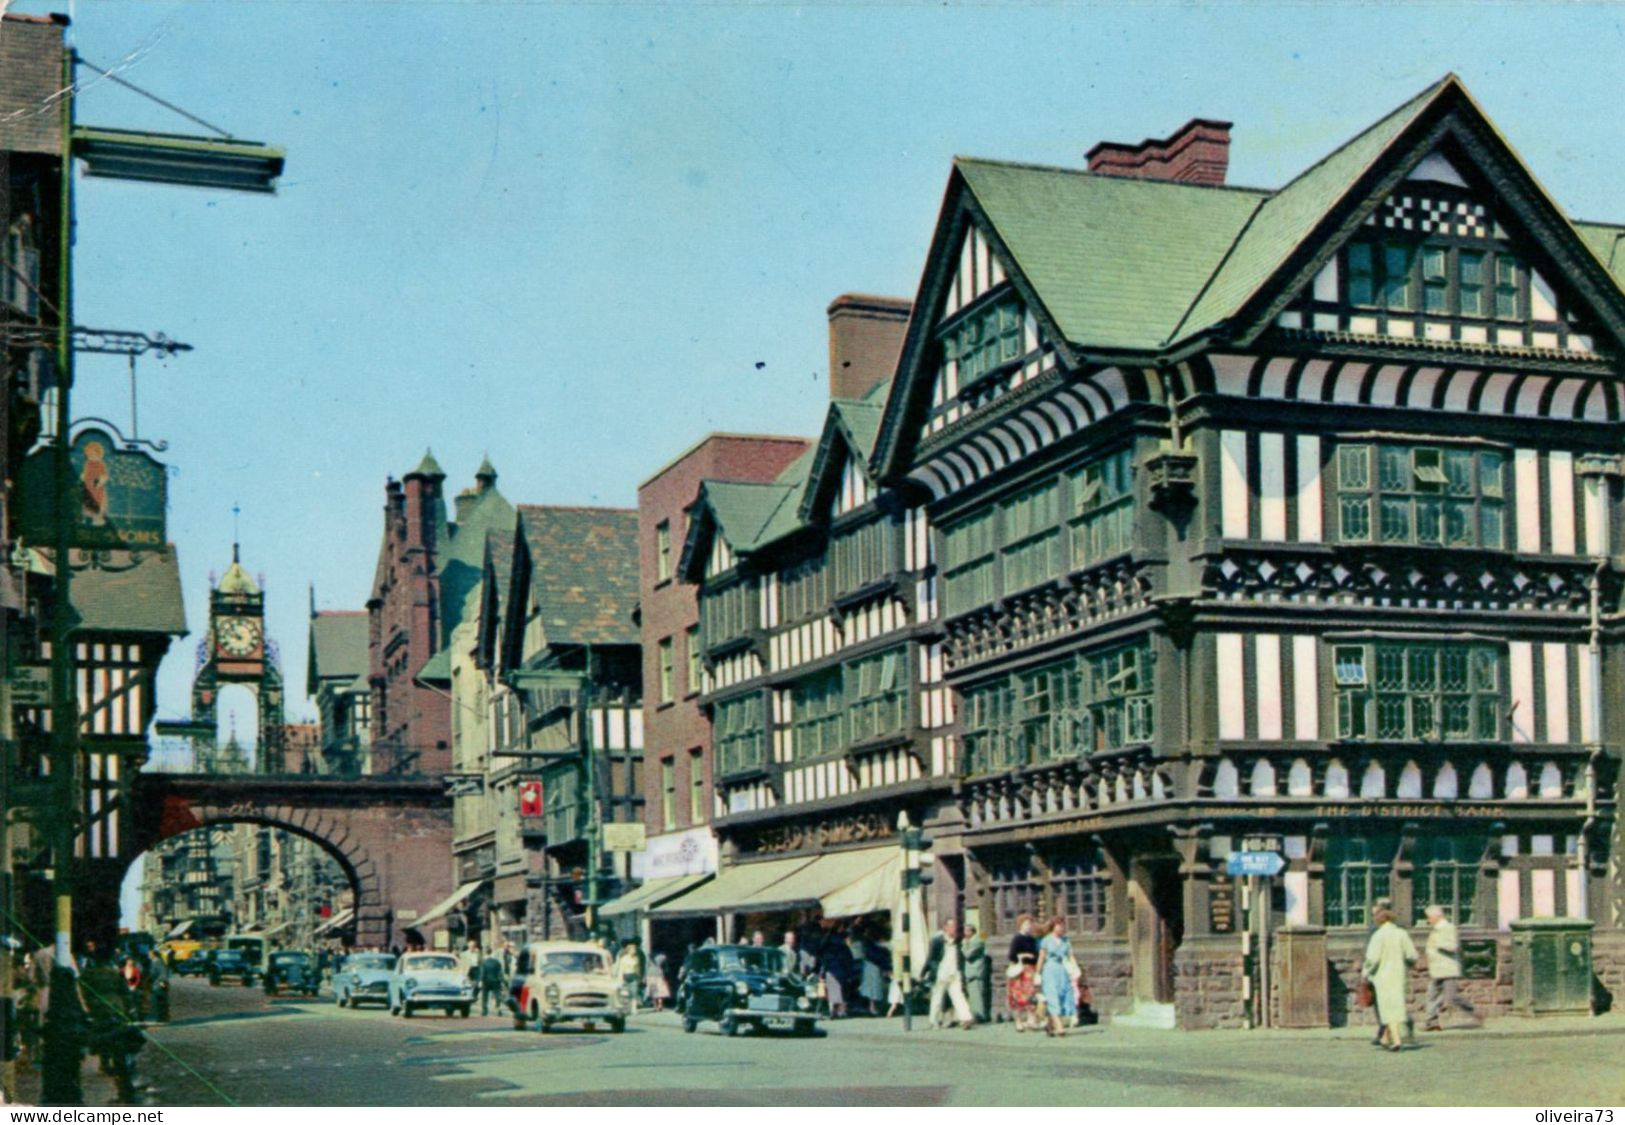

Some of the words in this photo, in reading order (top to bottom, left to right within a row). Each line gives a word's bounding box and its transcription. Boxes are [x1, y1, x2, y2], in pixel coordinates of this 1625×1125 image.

[1315, 805, 1349, 817] THE
[1361, 805, 1442, 817] DISTRICT
[1455, 805, 1506, 817] BANK
[819, 814, 892, 845] SIMPSON
